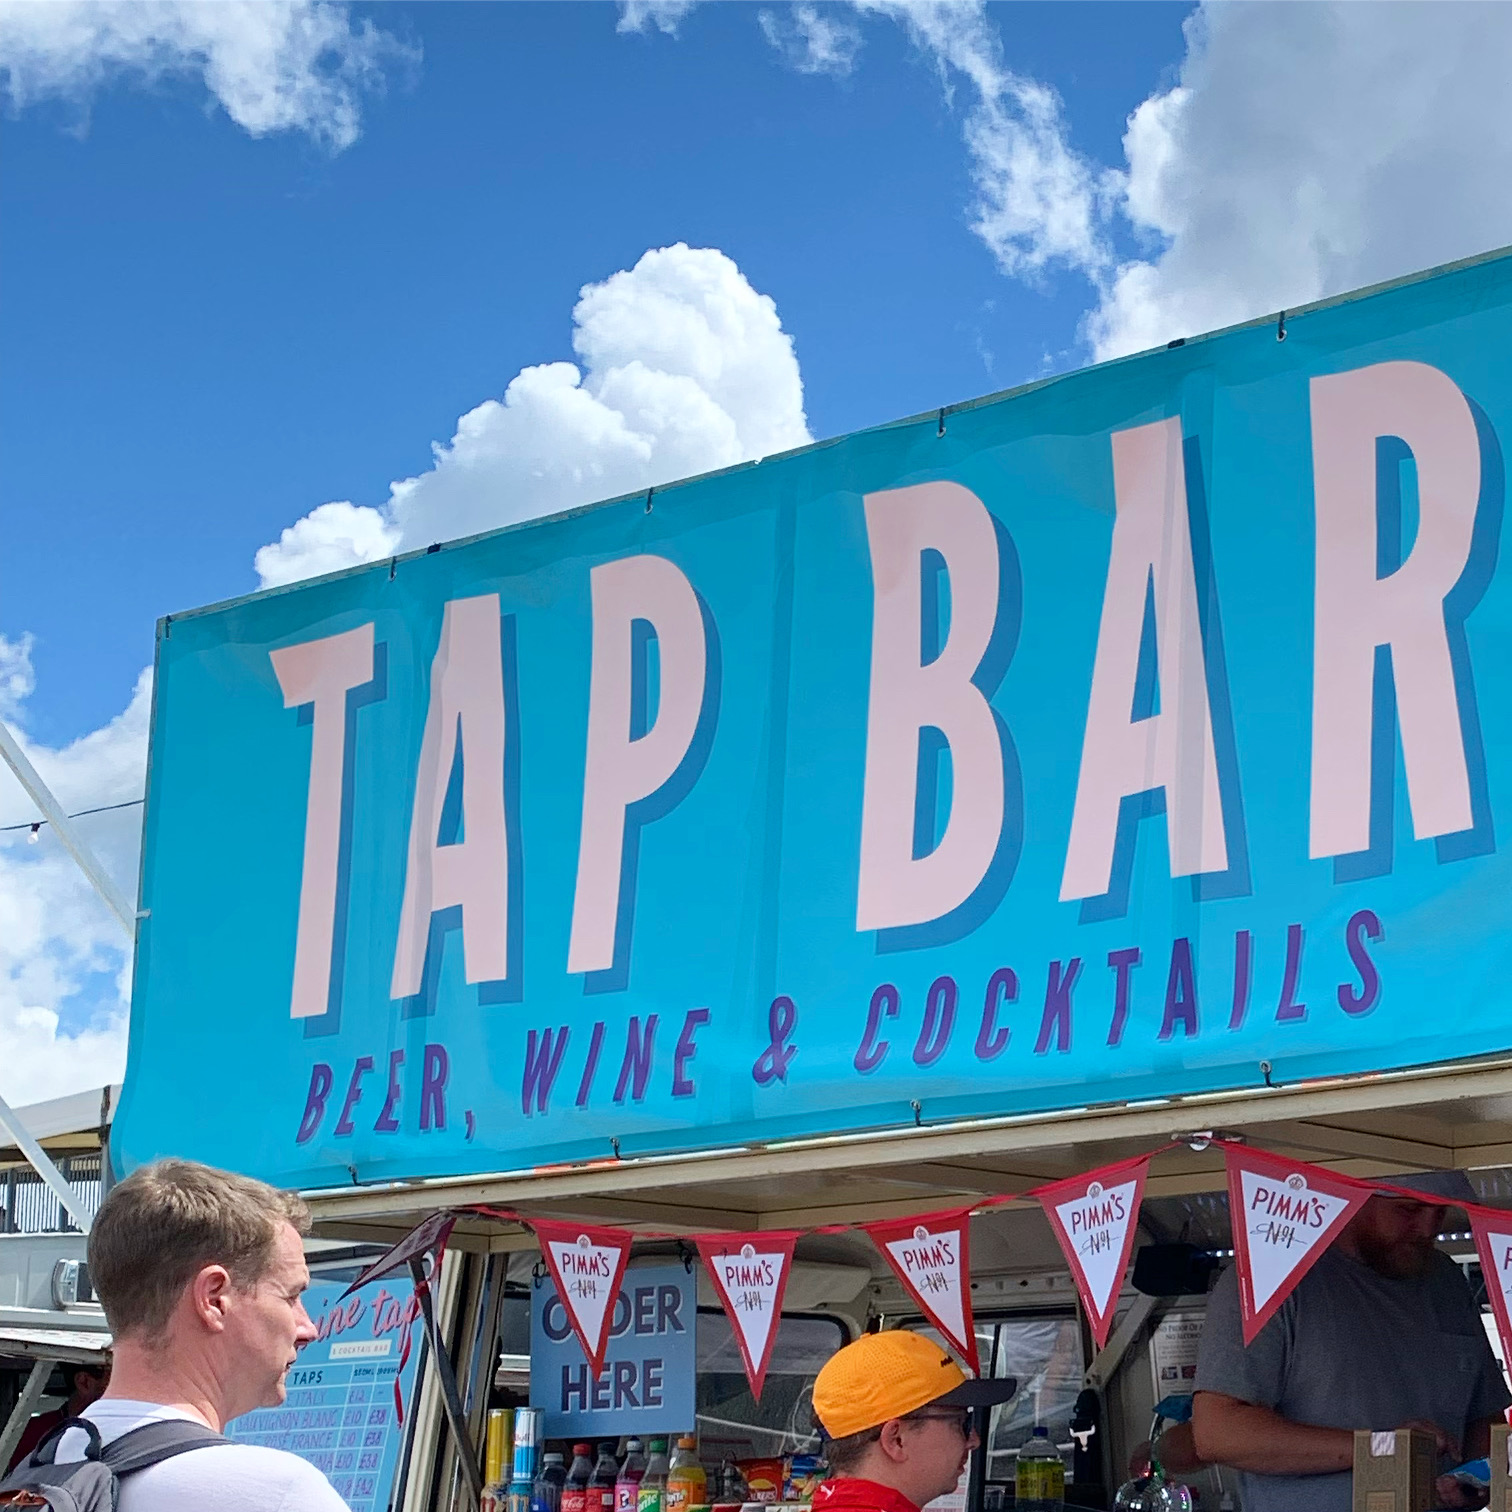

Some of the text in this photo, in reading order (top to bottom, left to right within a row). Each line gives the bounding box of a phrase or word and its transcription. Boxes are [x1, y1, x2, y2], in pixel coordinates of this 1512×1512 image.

[269, 361, 1504, 1036] TAP BAR
[295, 909, 1387, 1143] BEER, WINE & COCKTAILS
[1071, 1193, 1125, 1235] PIMM'S
[1251, 1187, 1327, 1228] PIMM'S
[562, 1252, 610, 1277] PIMM'S
[725, 1260, 773, 1287] PIMM'S
[903, 1239, 954, 1272] PIMM'S
[316, 1296, 366, 1342] ine
[543, 1285, 686, 1343] ODER
[293, 1371, 324, 1385] TAPS
[562, 1359, 664, 1414] HERE
